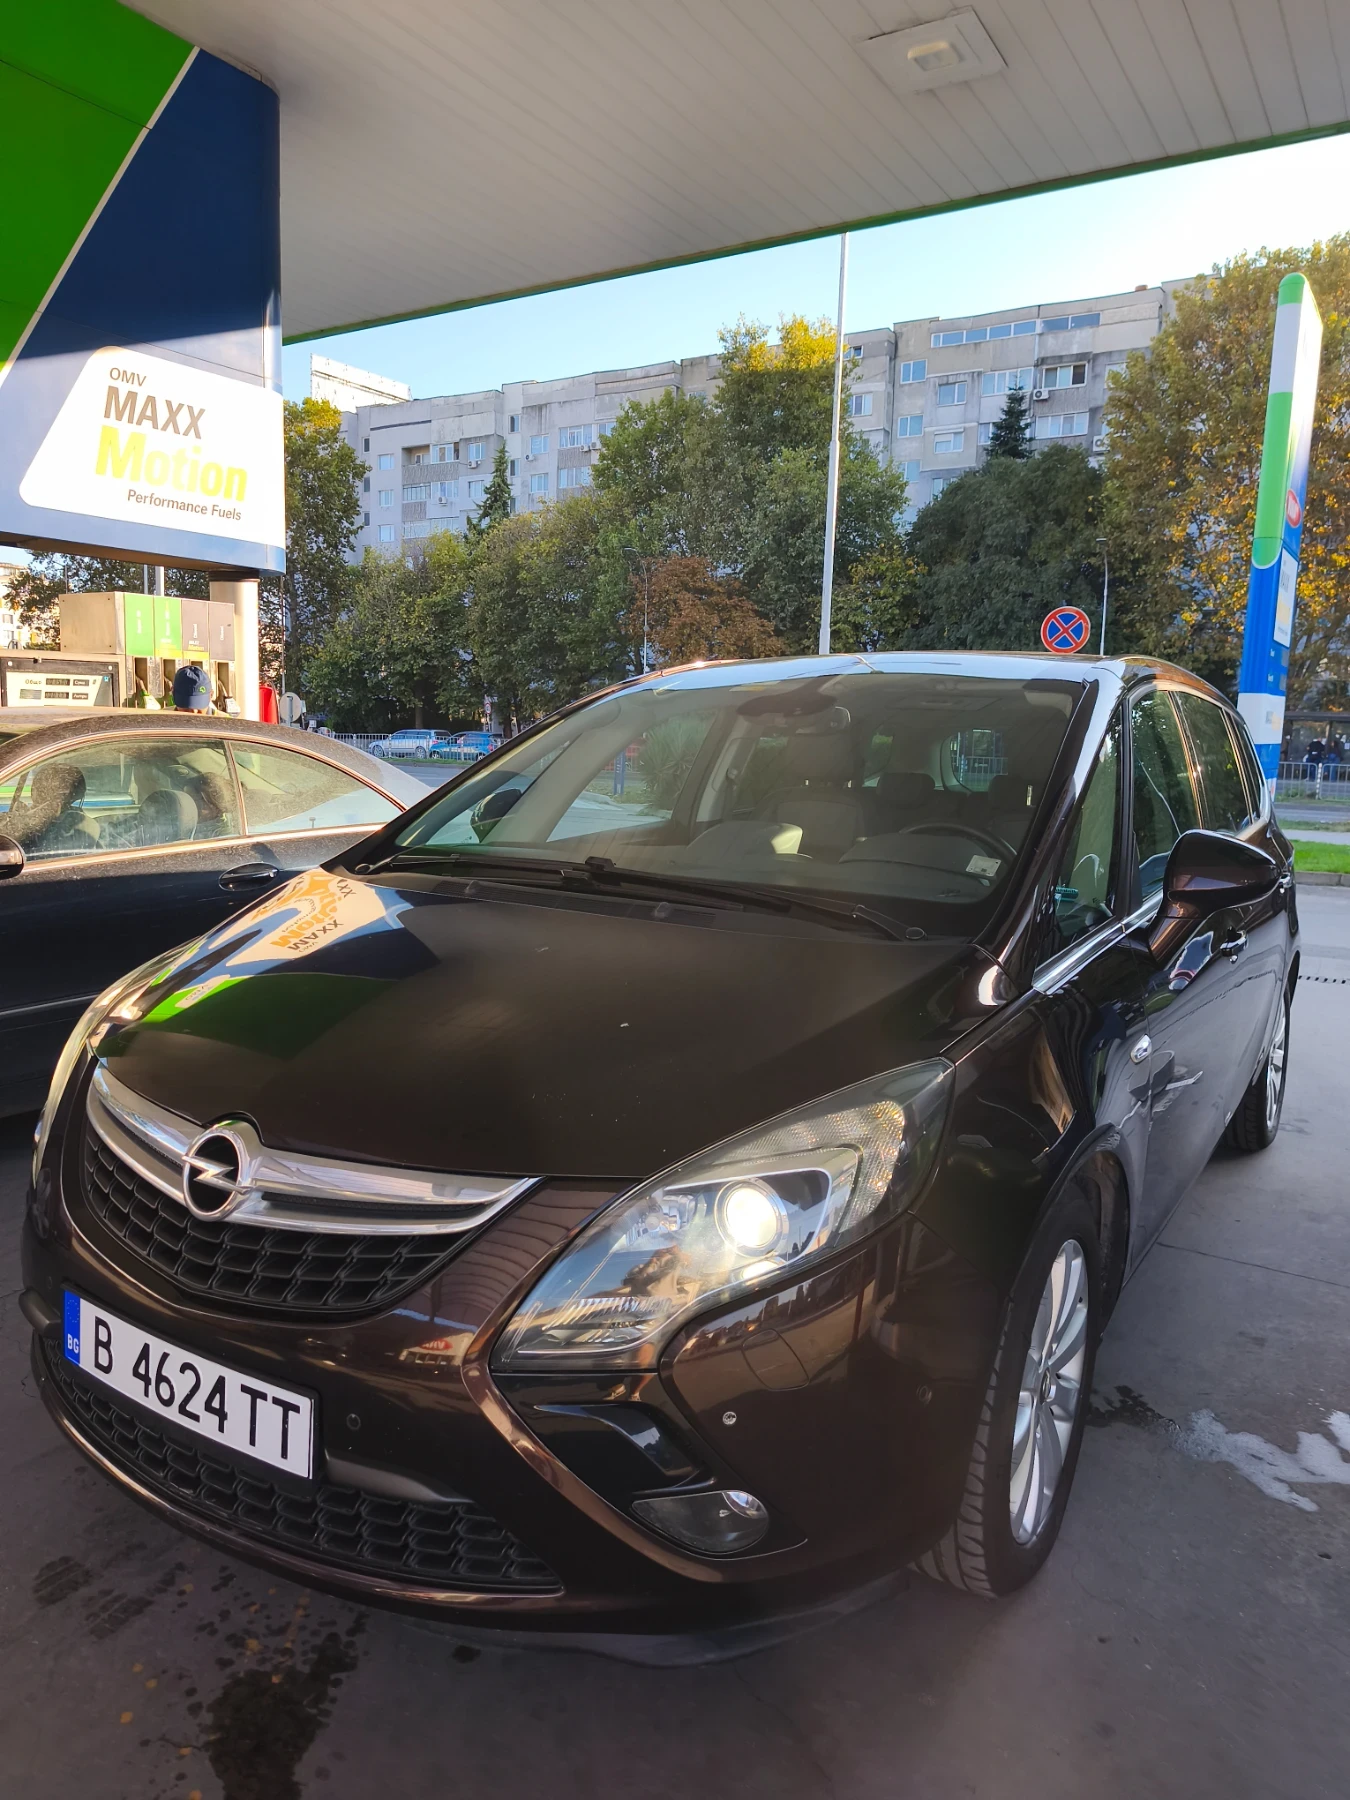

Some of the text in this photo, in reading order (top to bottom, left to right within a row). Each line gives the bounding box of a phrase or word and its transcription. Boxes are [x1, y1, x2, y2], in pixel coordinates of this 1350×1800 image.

[109, 367, 147, 387] OMV
[103, 385, 206, 440] MAXX
[95, 424, 248, 502] Motion
[127, 489, 242, 521] Performance Fuels
[67, 1333, 79, 1354] BG
[94, 1315, 301, 1460] B 4624 TT
